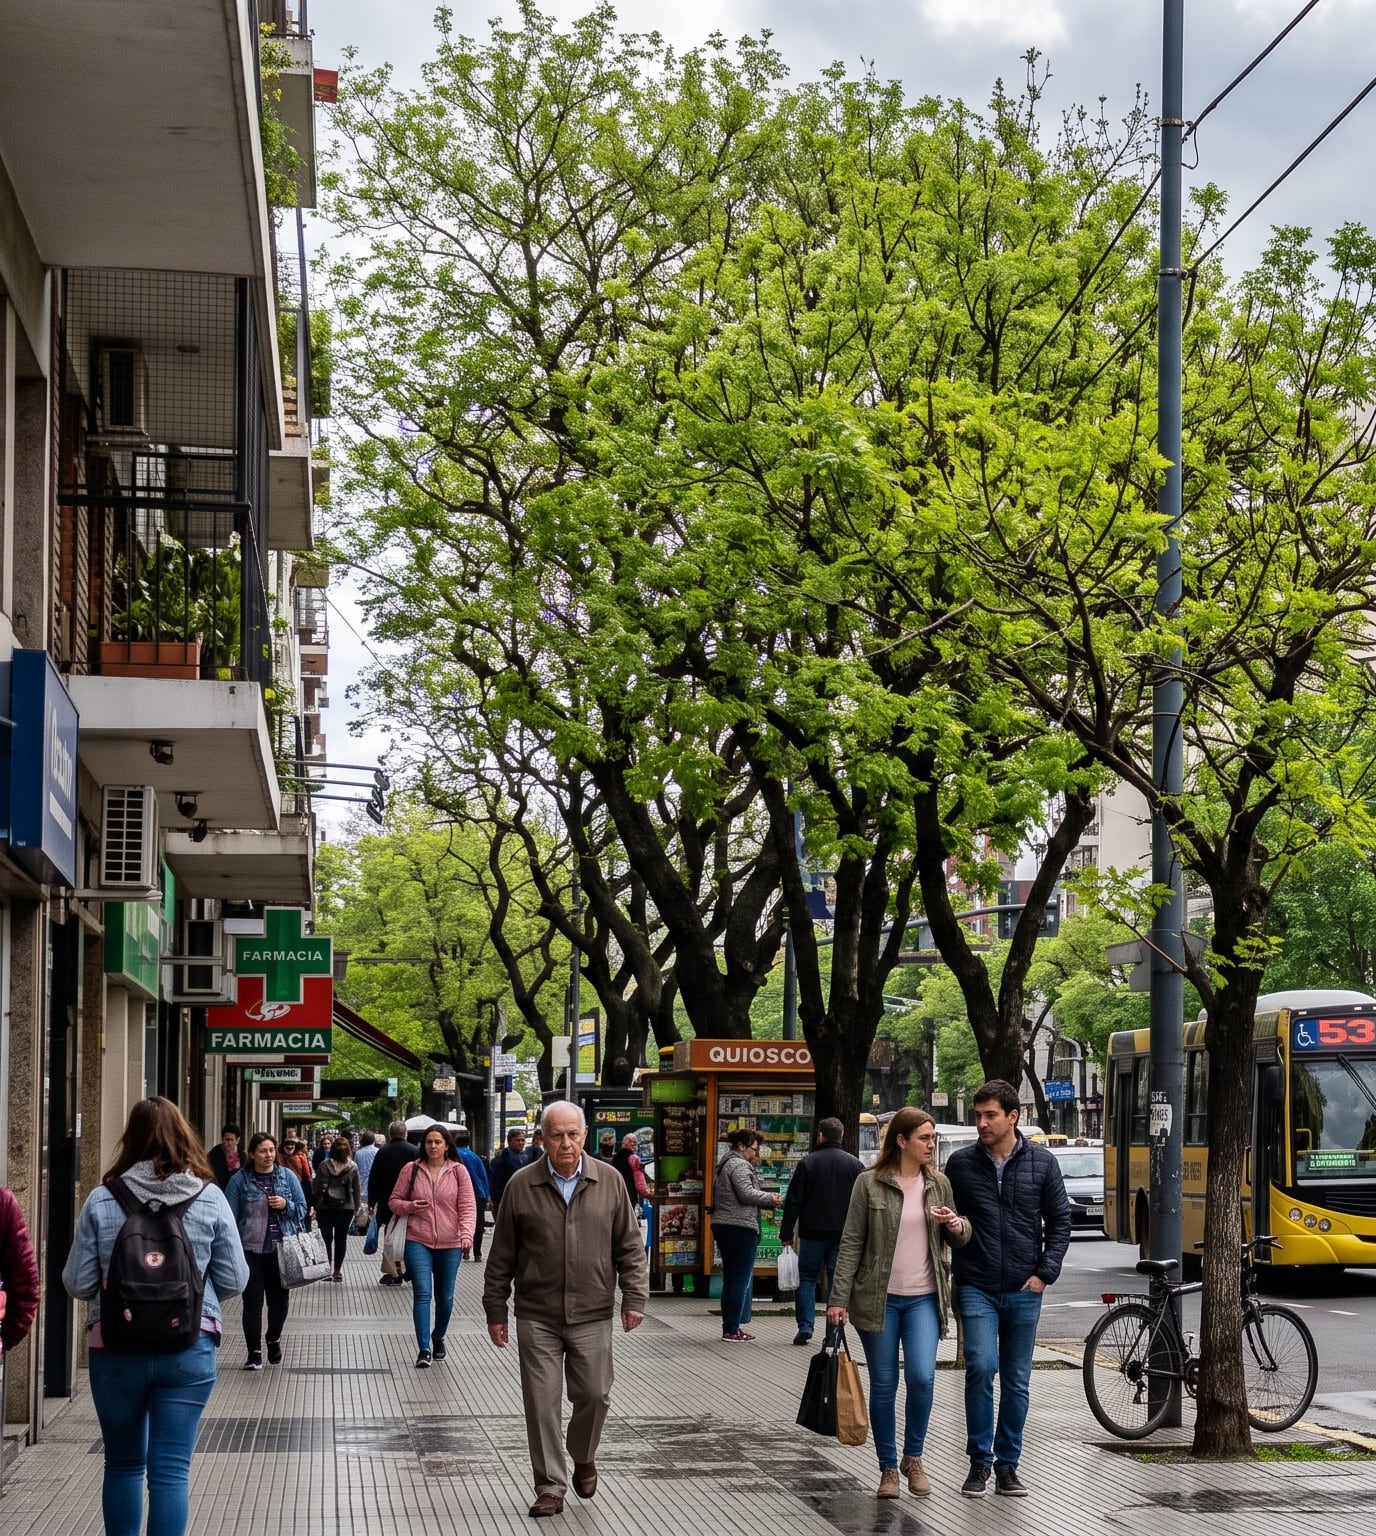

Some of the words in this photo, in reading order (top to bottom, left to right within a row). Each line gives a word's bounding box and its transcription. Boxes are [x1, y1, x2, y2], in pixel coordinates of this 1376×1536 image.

[243, 951, 323, 961] FARMACIA
[1319, 1018, 1376, 1044] 53
[211, 1033, 326, 1048] FARMACIA
[709, 1047, 811, 1064] QUIOSCO
